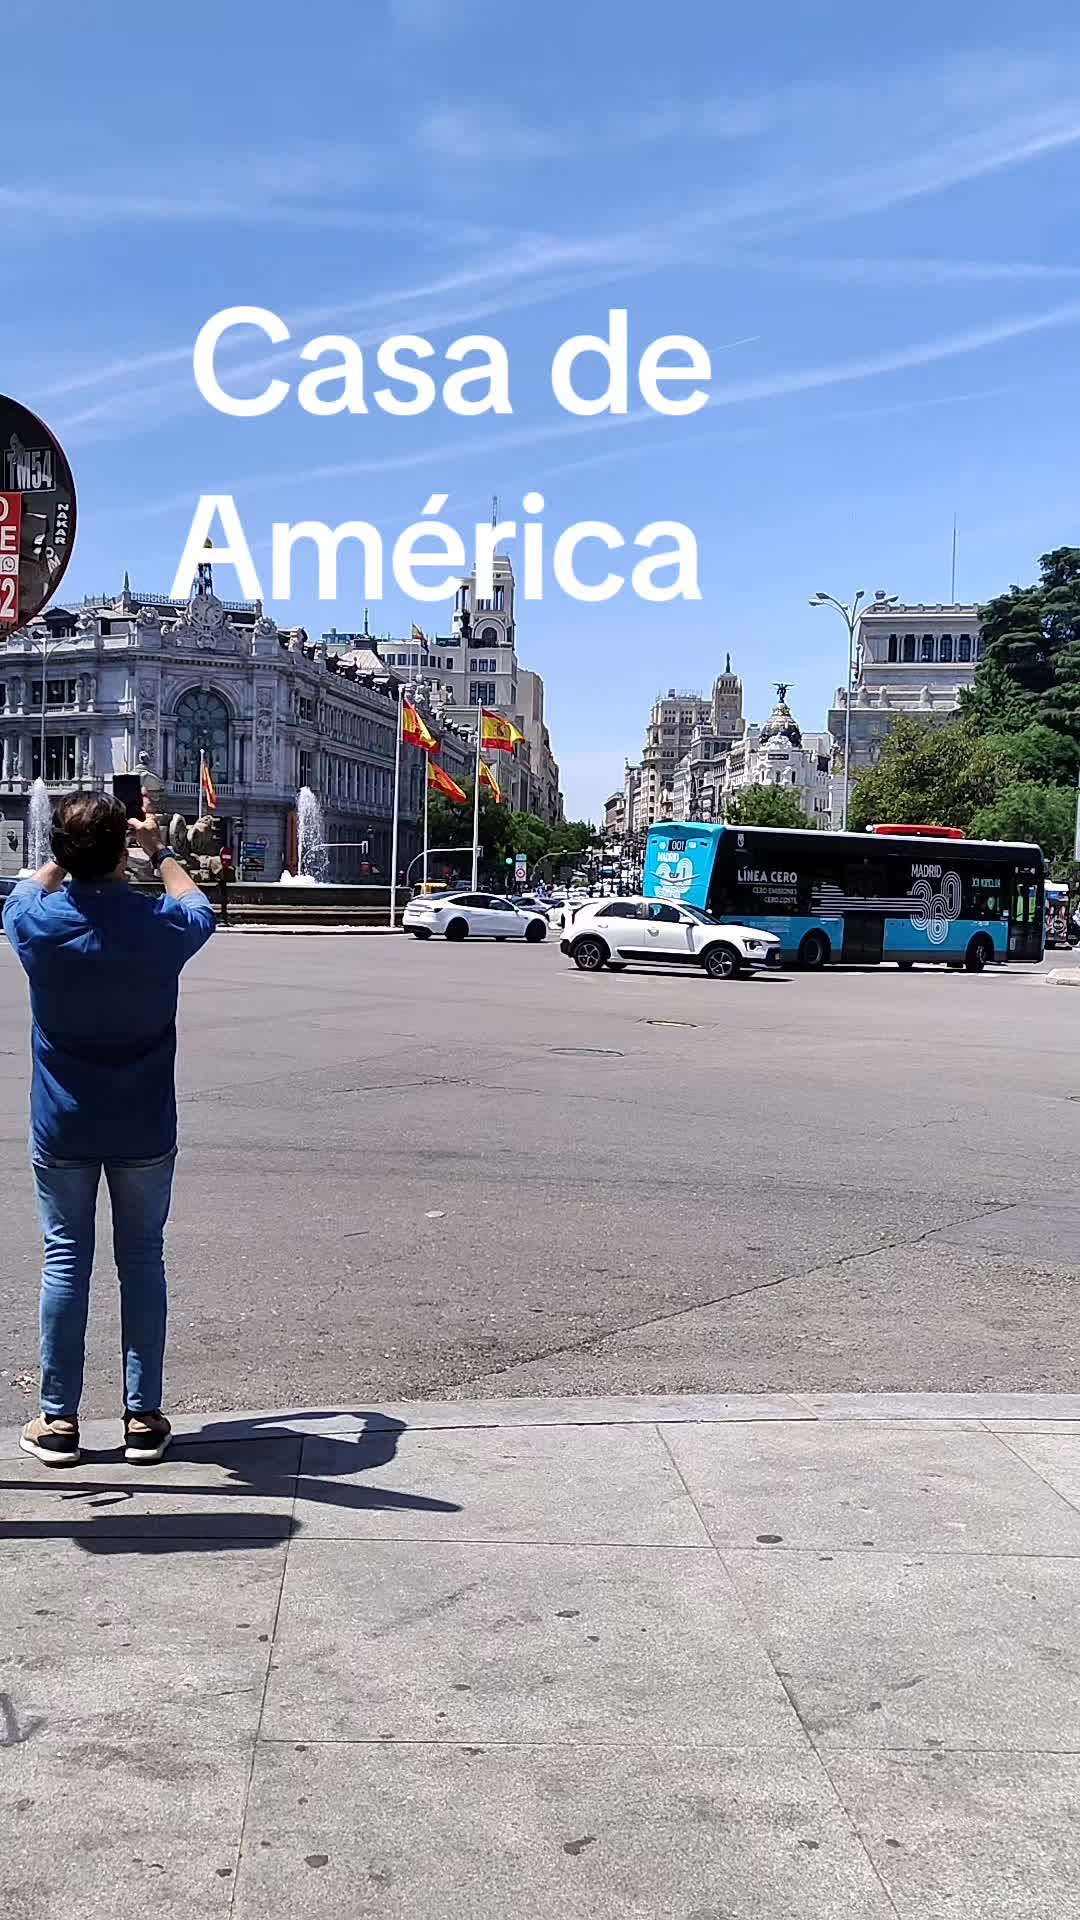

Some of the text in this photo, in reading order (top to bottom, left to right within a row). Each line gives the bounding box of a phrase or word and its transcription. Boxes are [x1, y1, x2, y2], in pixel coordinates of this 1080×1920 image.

[55, 503, 69, 545] NAKAR
[657, 851, 680, 863] MADRID
[737, 866, 798, 883] LÍNEA CERO
[911, 863, 942, 879] MADRID
[911, 871, 962, 945] 360
